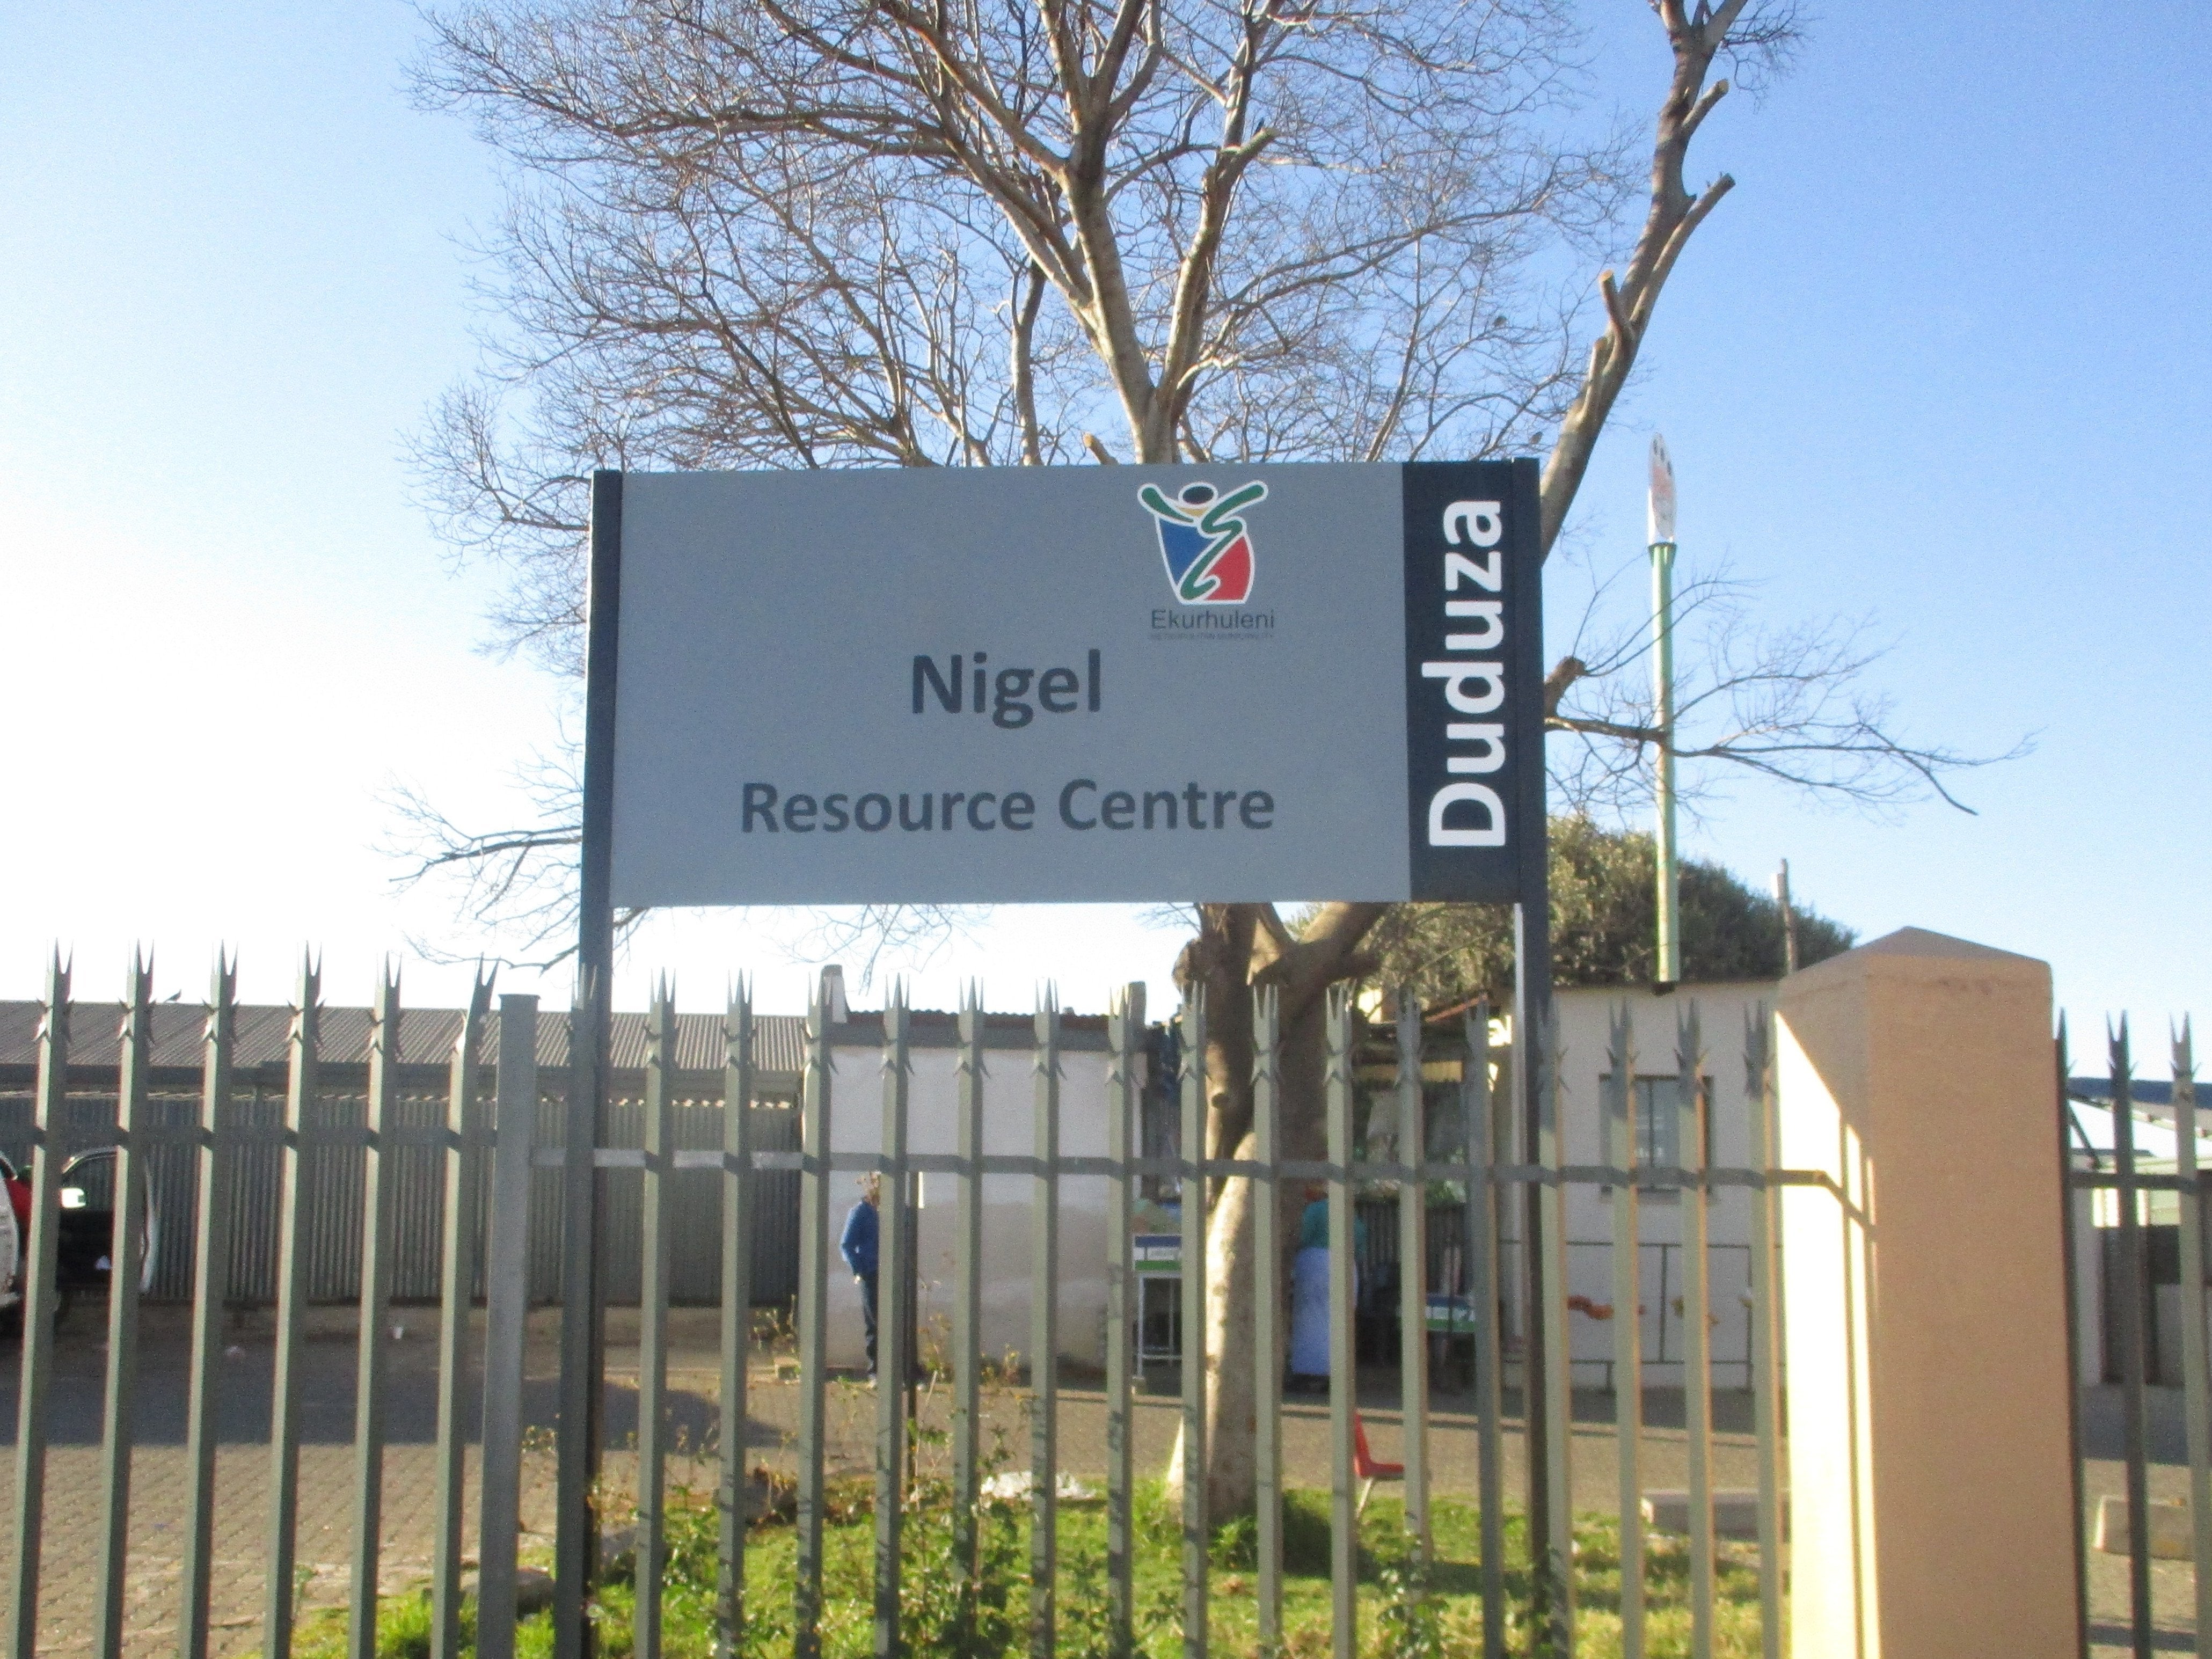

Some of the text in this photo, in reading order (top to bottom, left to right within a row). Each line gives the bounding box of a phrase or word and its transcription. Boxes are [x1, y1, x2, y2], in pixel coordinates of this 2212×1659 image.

[1151, 609, 1274, 629] Ekurhuleni
[912, 649, 1100, 729] Nigel
[1422, 500, 1506, 846] Duduza
[742, 779, 1274, 833] Resource Centre
